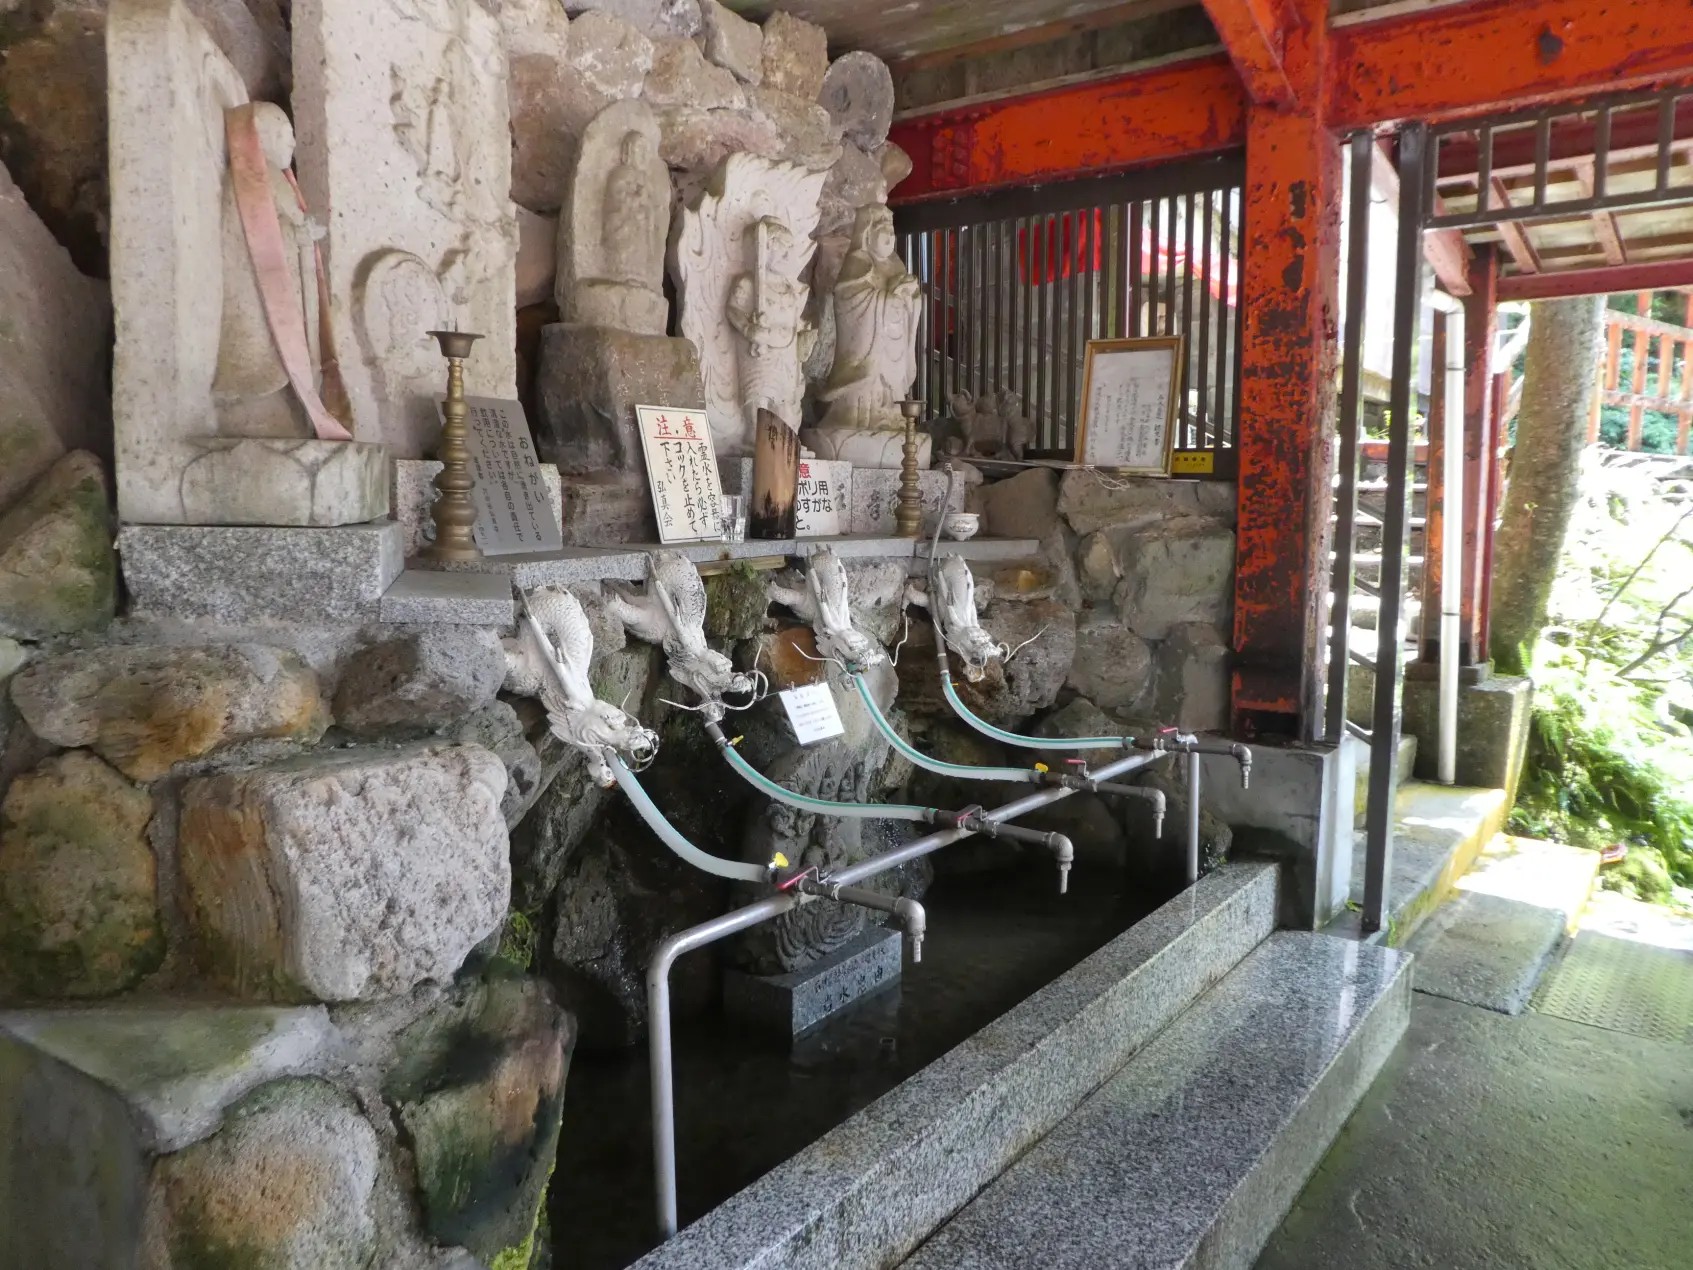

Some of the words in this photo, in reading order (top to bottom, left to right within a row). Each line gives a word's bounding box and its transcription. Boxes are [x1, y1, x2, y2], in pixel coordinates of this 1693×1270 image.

[518, 436, 545, 503] おねがい
[660, 441, 676, 484] 下さい
[673, 441, 698, 534] コックを止めて
[657, 481, 674, 527] 弘真会
